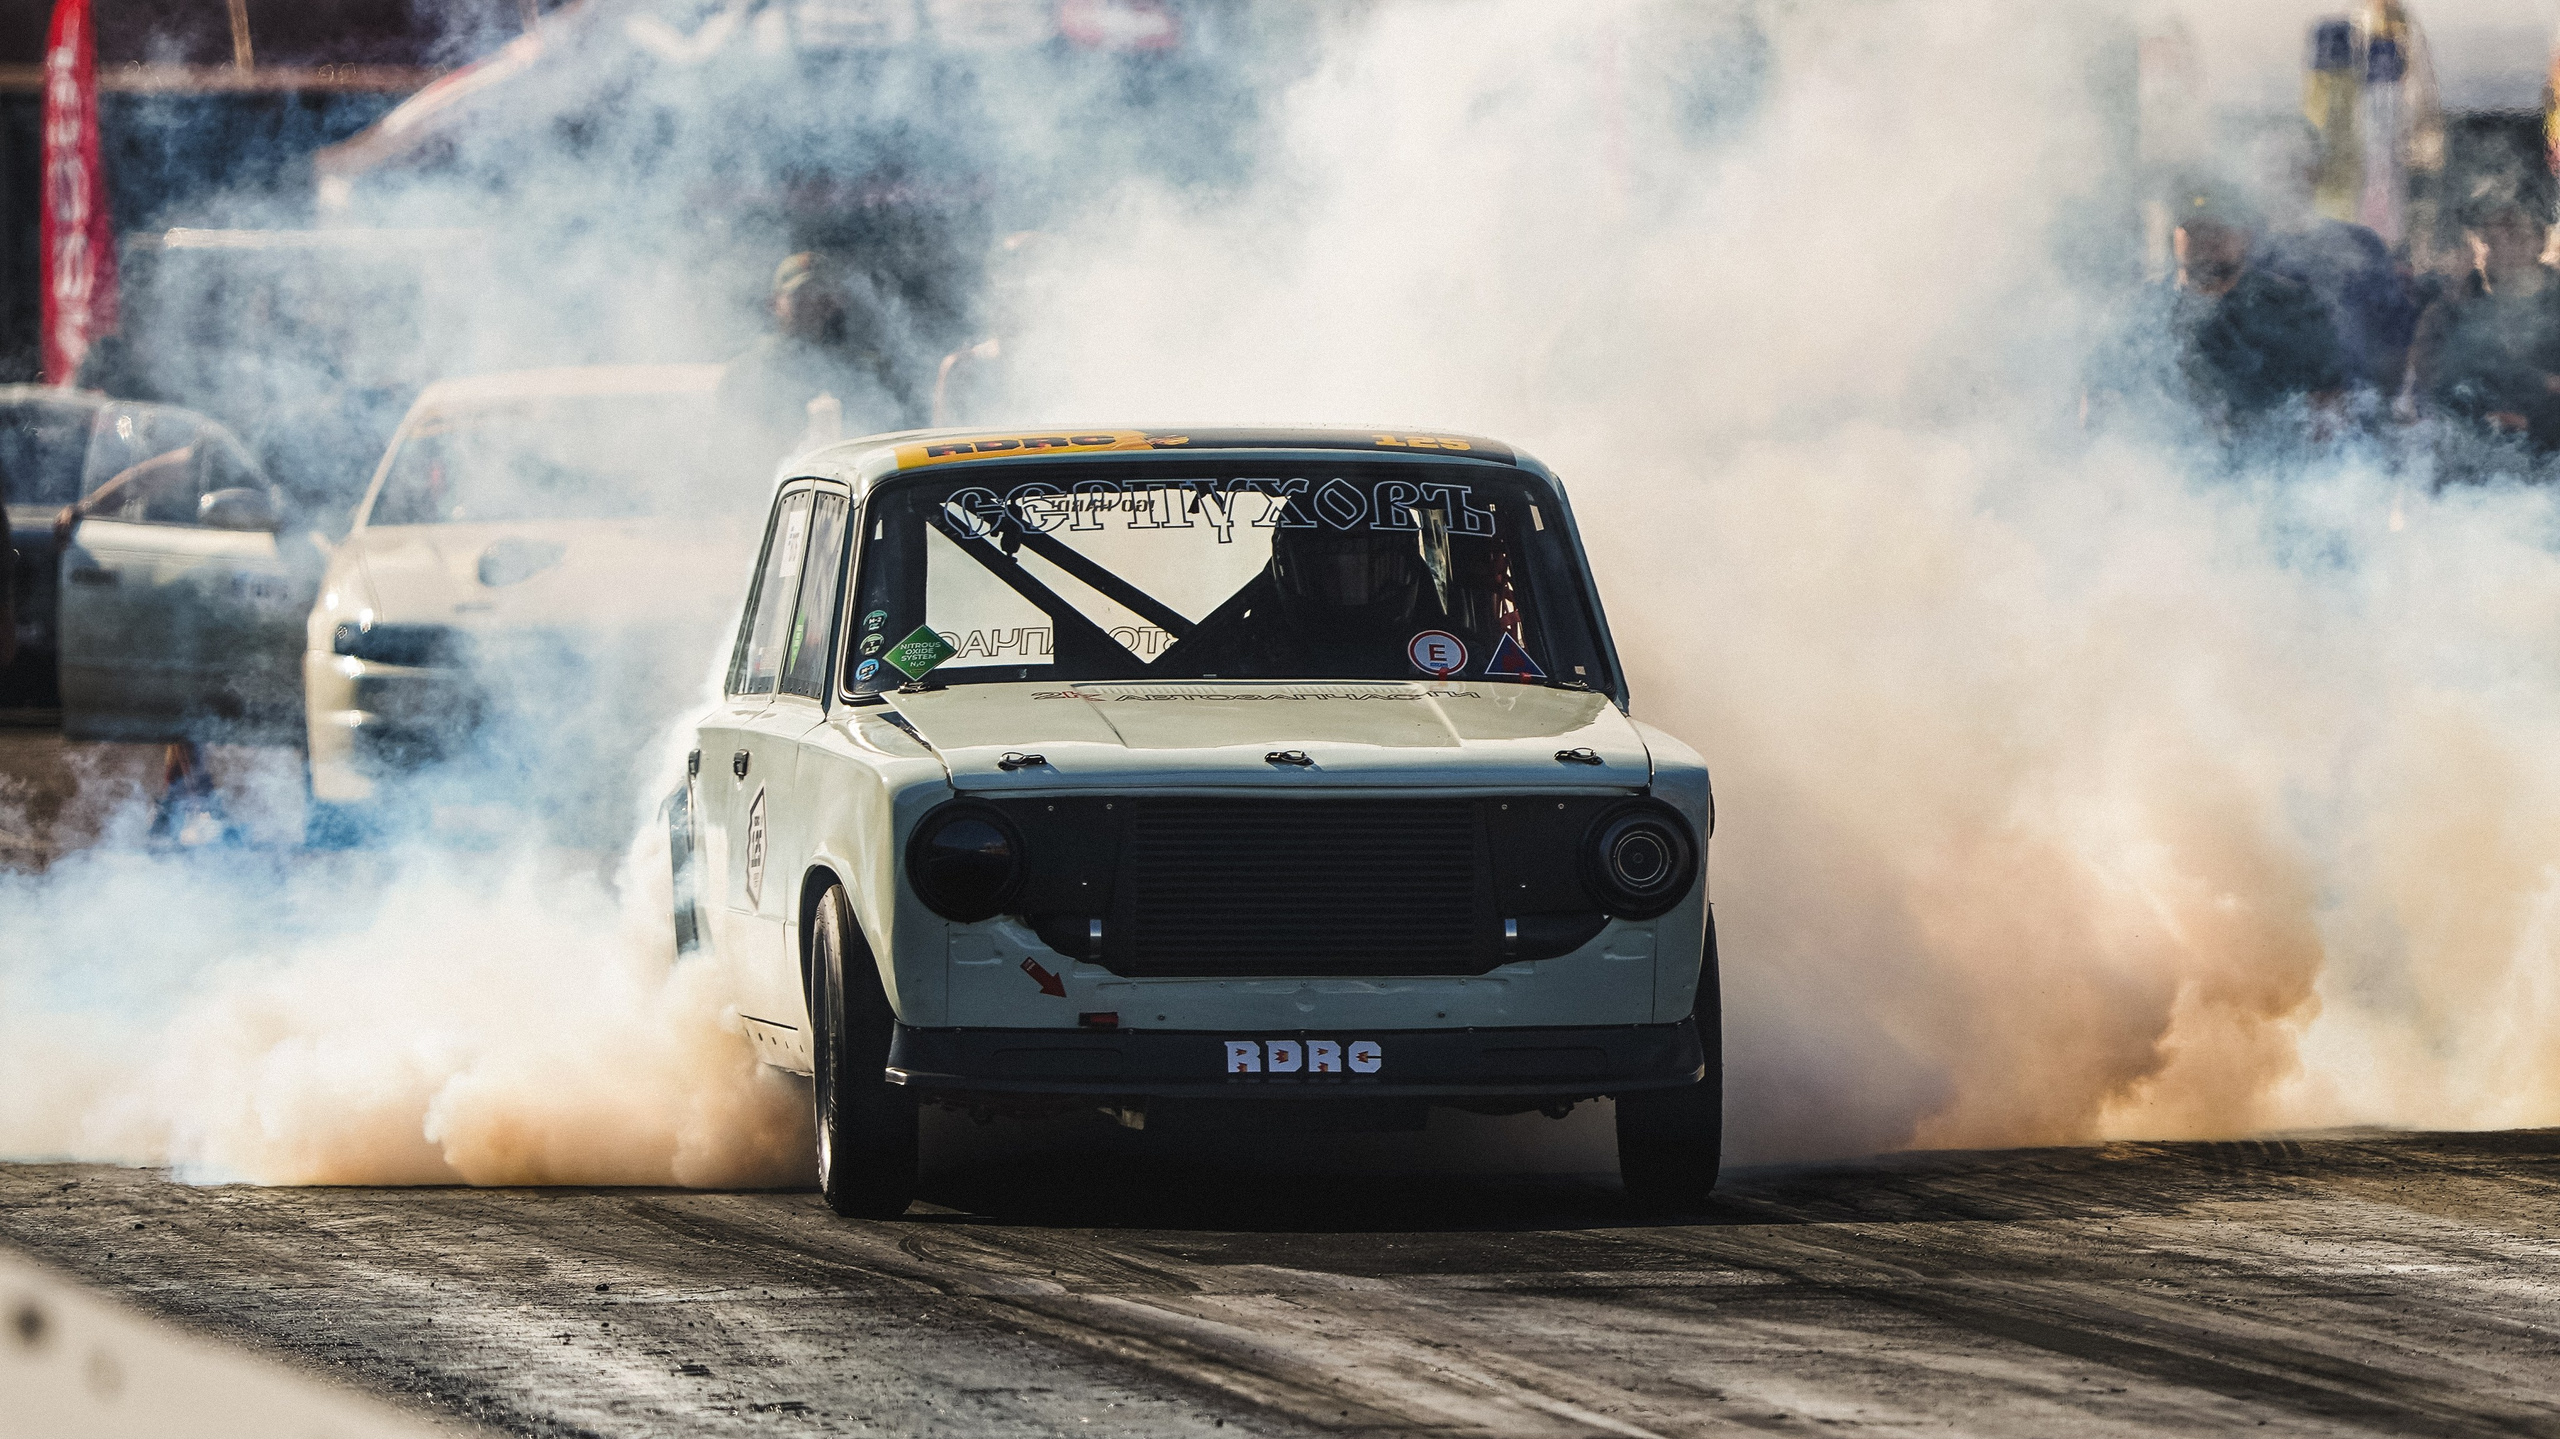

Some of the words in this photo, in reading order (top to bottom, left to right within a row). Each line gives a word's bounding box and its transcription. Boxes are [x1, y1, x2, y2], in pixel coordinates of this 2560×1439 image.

[1372, 435, 1471, 450] 125
[900, 641, 941, 650] NITROUS
[905, 647, 934, 655] OXIDE
[901, 653, 937, 662] SYSTEM
[1428, 643, 1448, 662] E
[1224, 1040, 1381, 1073] RDRC
